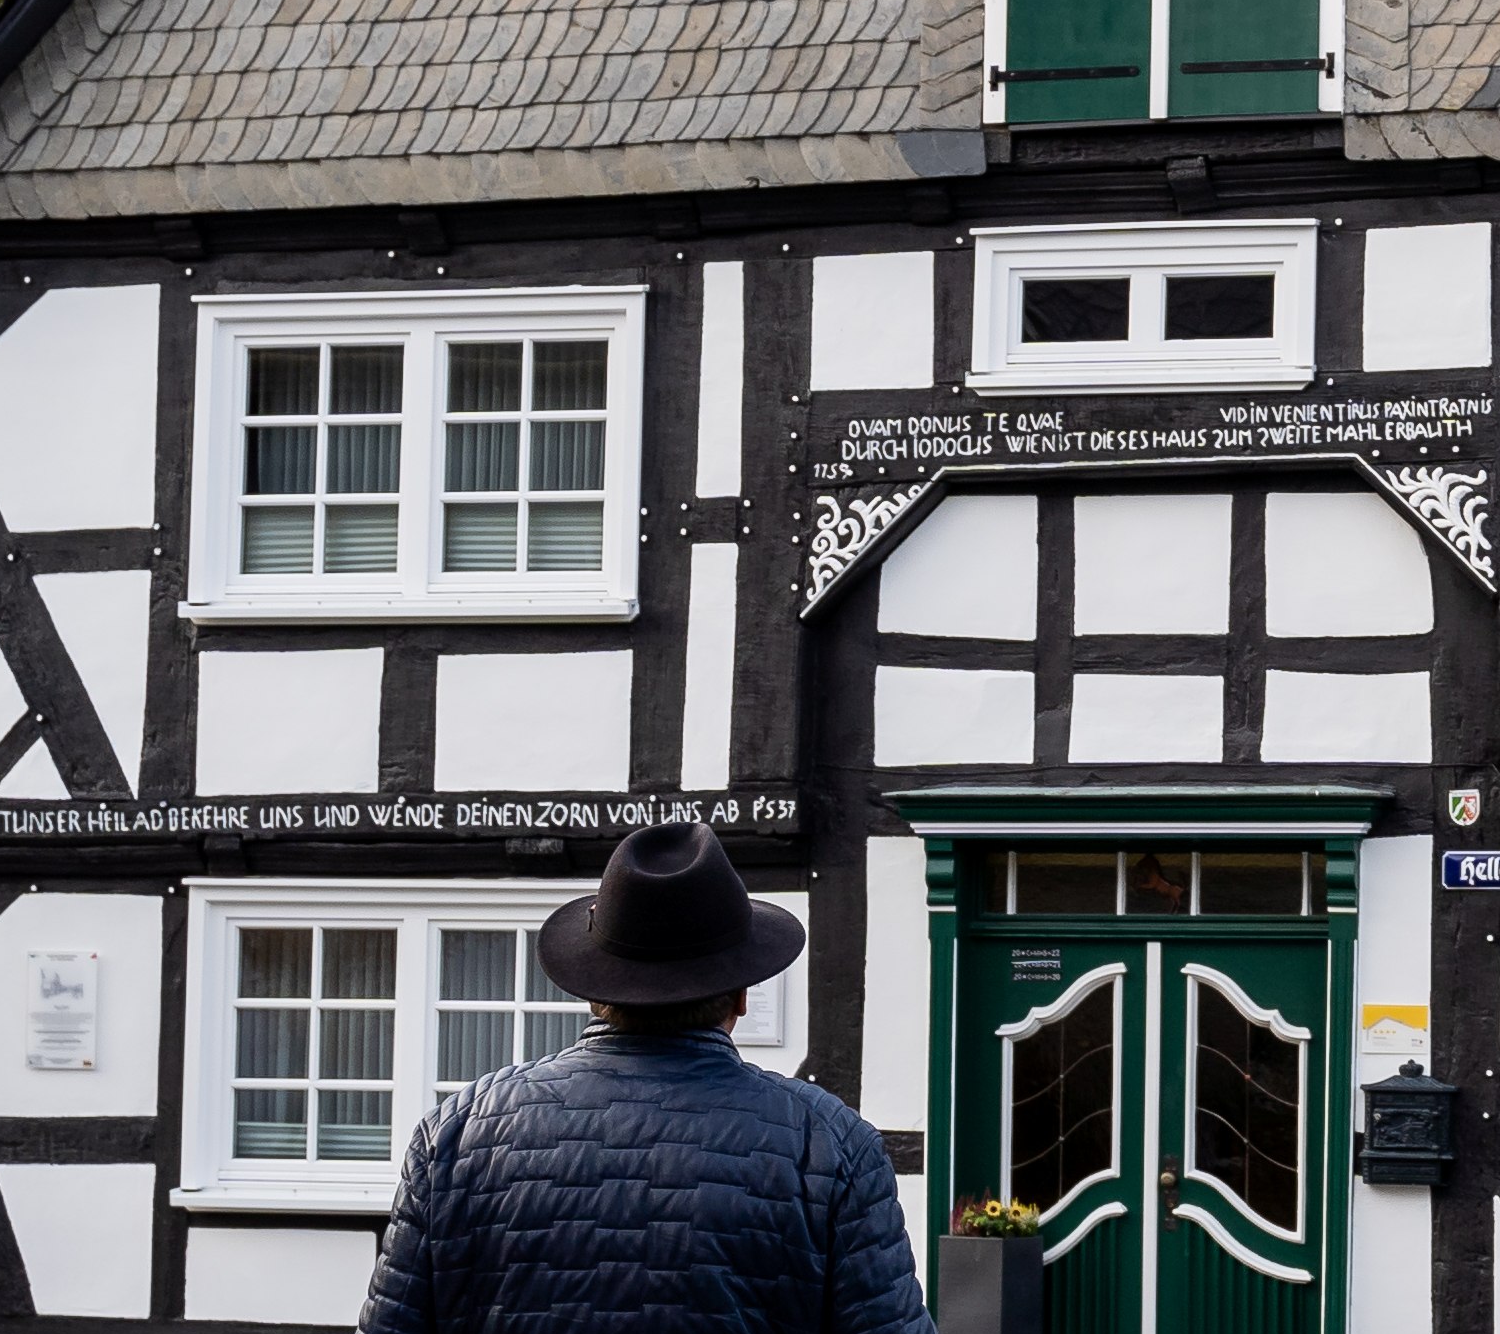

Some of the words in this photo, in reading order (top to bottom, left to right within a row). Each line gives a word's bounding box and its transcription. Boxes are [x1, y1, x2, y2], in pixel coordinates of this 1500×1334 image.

[842, 438, 907, 461] DURCH
[1152, 428, 1207, 449] HAUS
[1326, 422, 1382, 443] MAHL
[168, 805, 250, 832] BEKEHRE
[259, 805, 304, 829] UNS
[314, 805, 359, 829] UND
[368, 804, 444, 830] WENDE
[536, 801, 599, 828] ZORN
[606, 801, 653, 826] VON
[660, 800, 703, 824] UNS
[710, 799, 740, 824] AB
